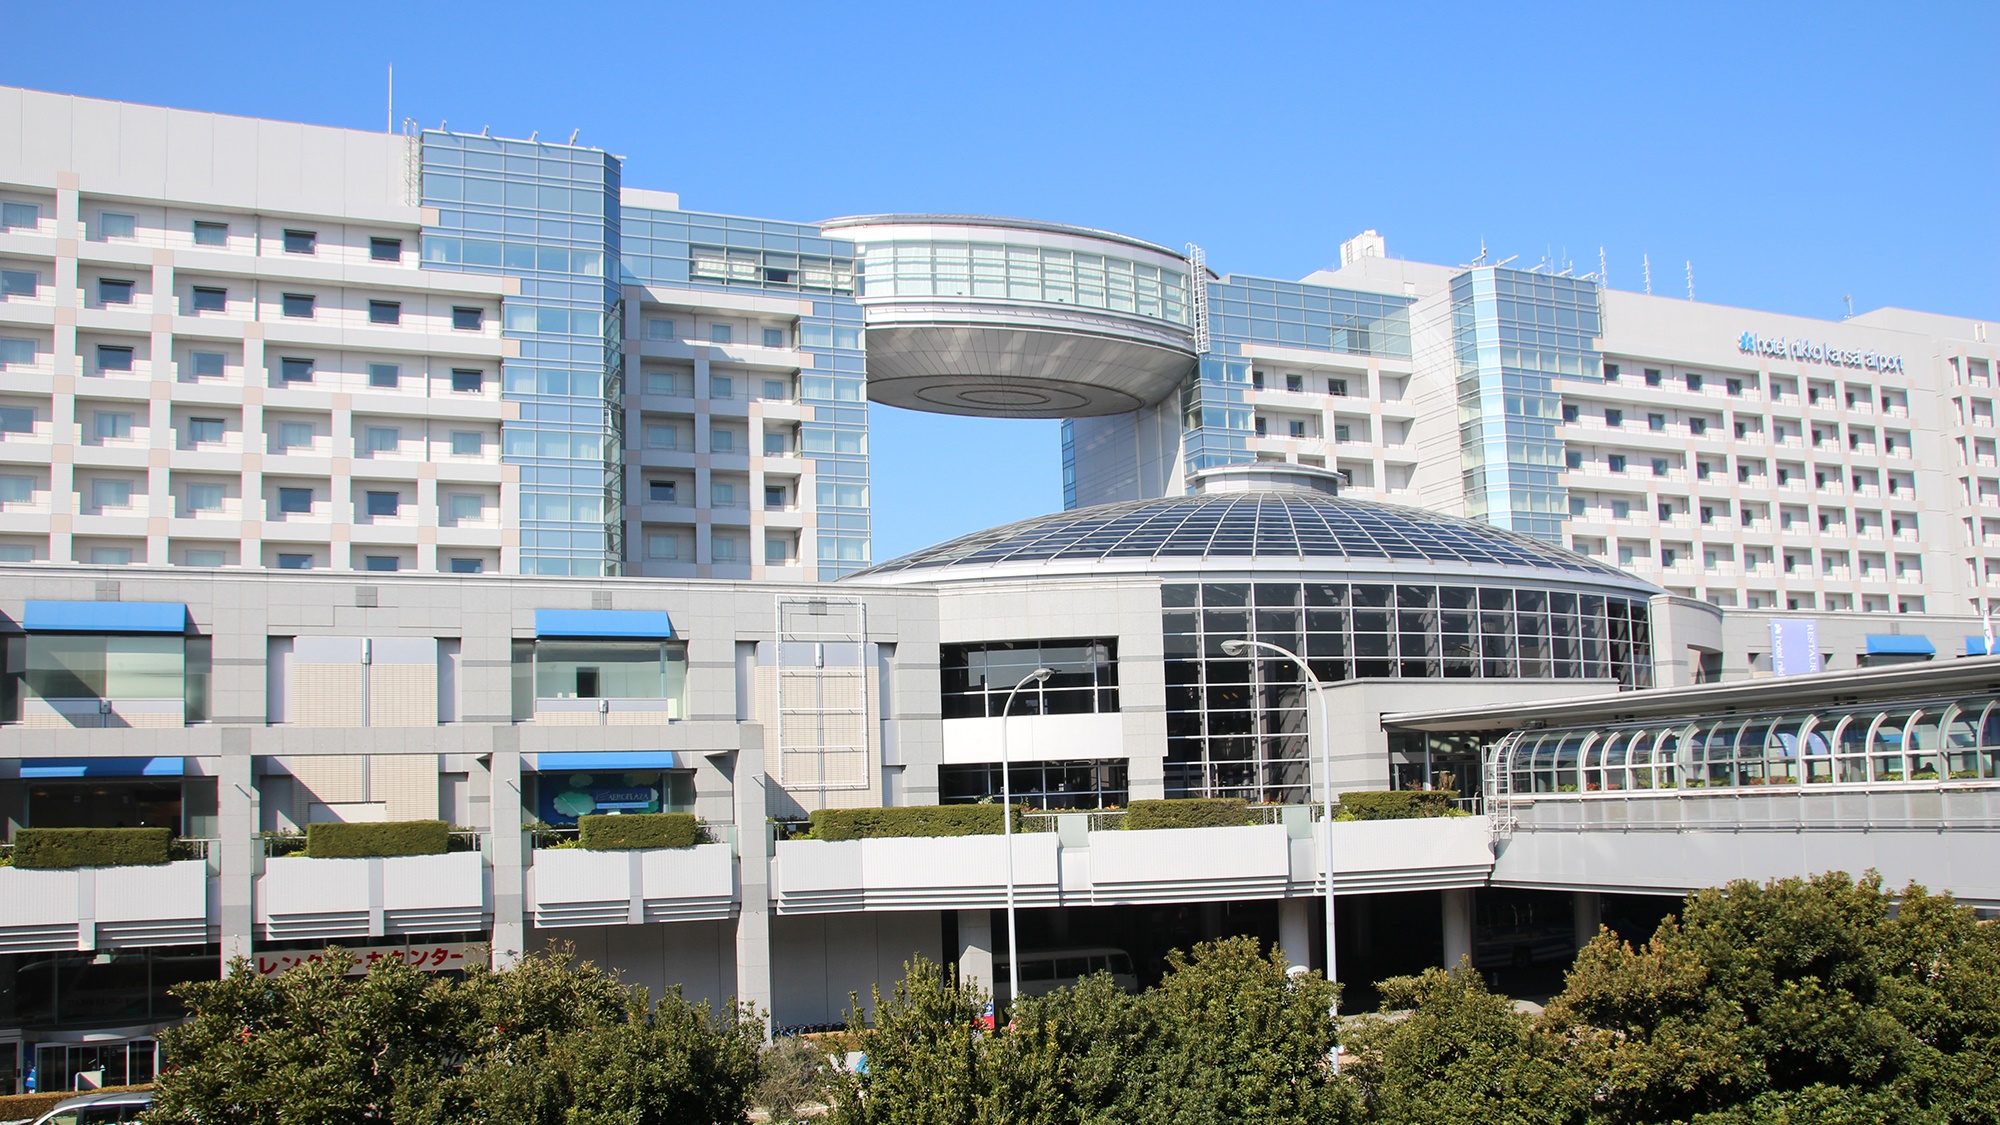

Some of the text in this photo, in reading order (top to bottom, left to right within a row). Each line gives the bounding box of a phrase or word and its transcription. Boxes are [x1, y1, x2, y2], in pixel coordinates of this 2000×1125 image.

[1755, 333, 1904, 374] hotel nikko kansai airport
[1775, 635, 1785, 659] hotel
[1806, 624, 1817, 672] RESTAUR
